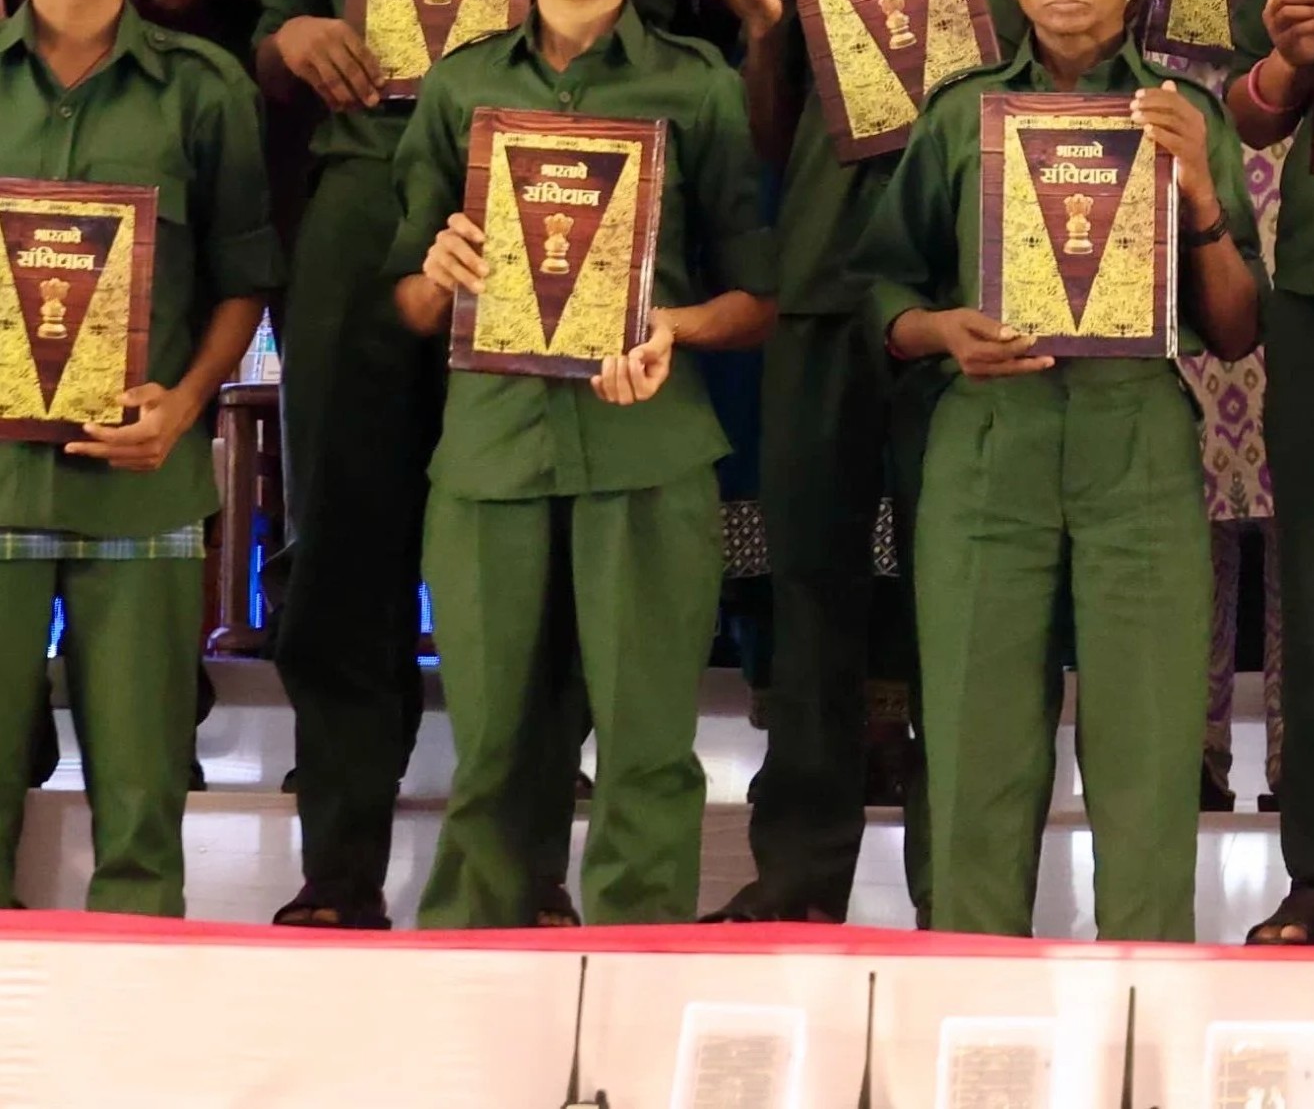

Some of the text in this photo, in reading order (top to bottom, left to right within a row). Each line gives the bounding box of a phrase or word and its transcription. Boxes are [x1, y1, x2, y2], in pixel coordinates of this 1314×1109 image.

[1040, 163, 1117, 184] संविधान
[523, 182, 600, 206] संविधान
[17, 247, 94, 270] संविधान
